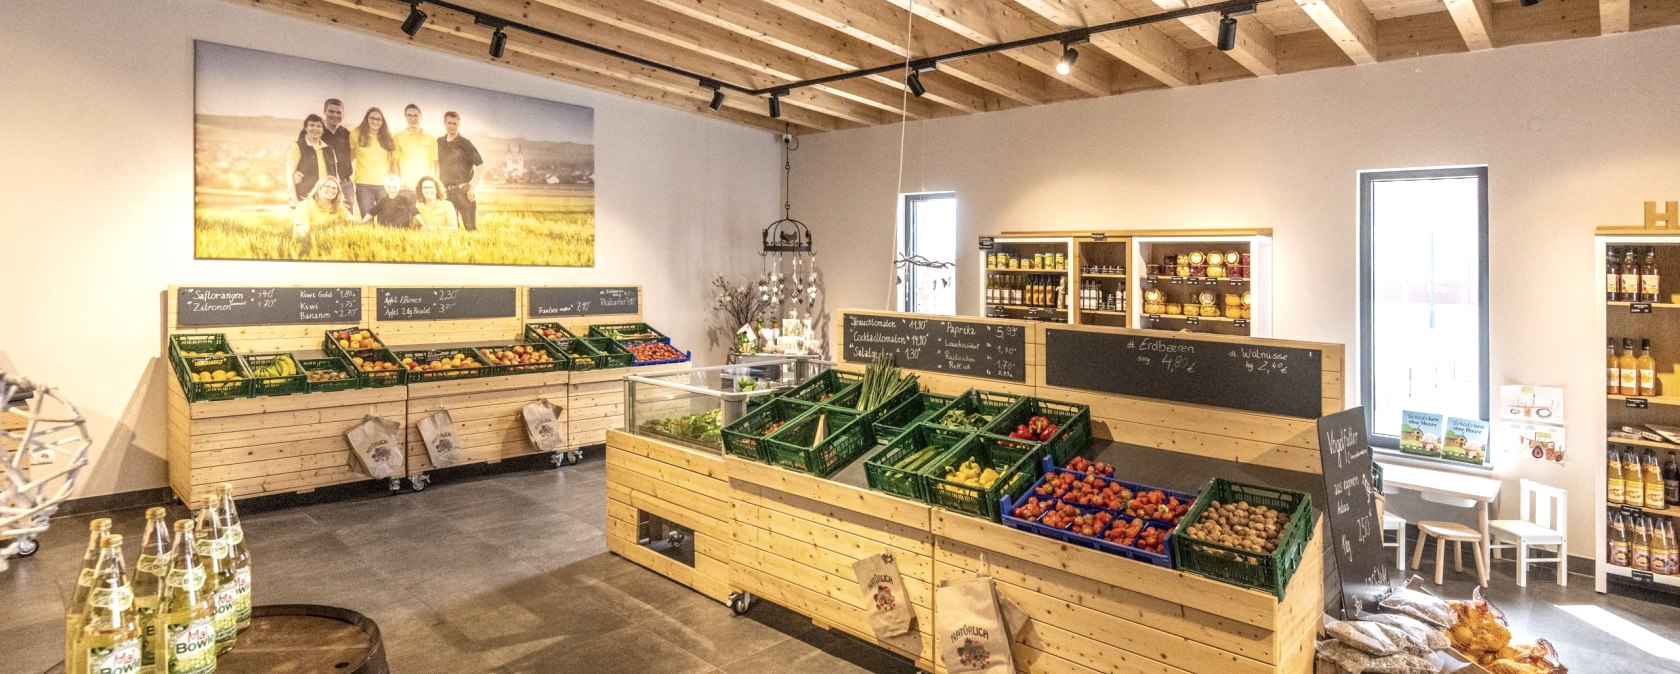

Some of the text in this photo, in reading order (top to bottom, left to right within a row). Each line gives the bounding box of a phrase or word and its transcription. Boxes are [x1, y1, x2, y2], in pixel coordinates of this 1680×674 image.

[300, 290, 316, 298] Kiwi
[318, 290, 334, 298] Gold
[193, 302, 232, 312] Zitronen
[300, 302, 319, 310] Kiwi
[946, 321, 977, 338] Paprika
[1138, 337, 1196, 354] Erdbeeren
[868, 573, 894, 592] NATÜRLICH
[187, 626, 208, 642] Mai
[950, 623, 989, 644] NATÜRLICH
[113, 649, 135, 666] Mai
